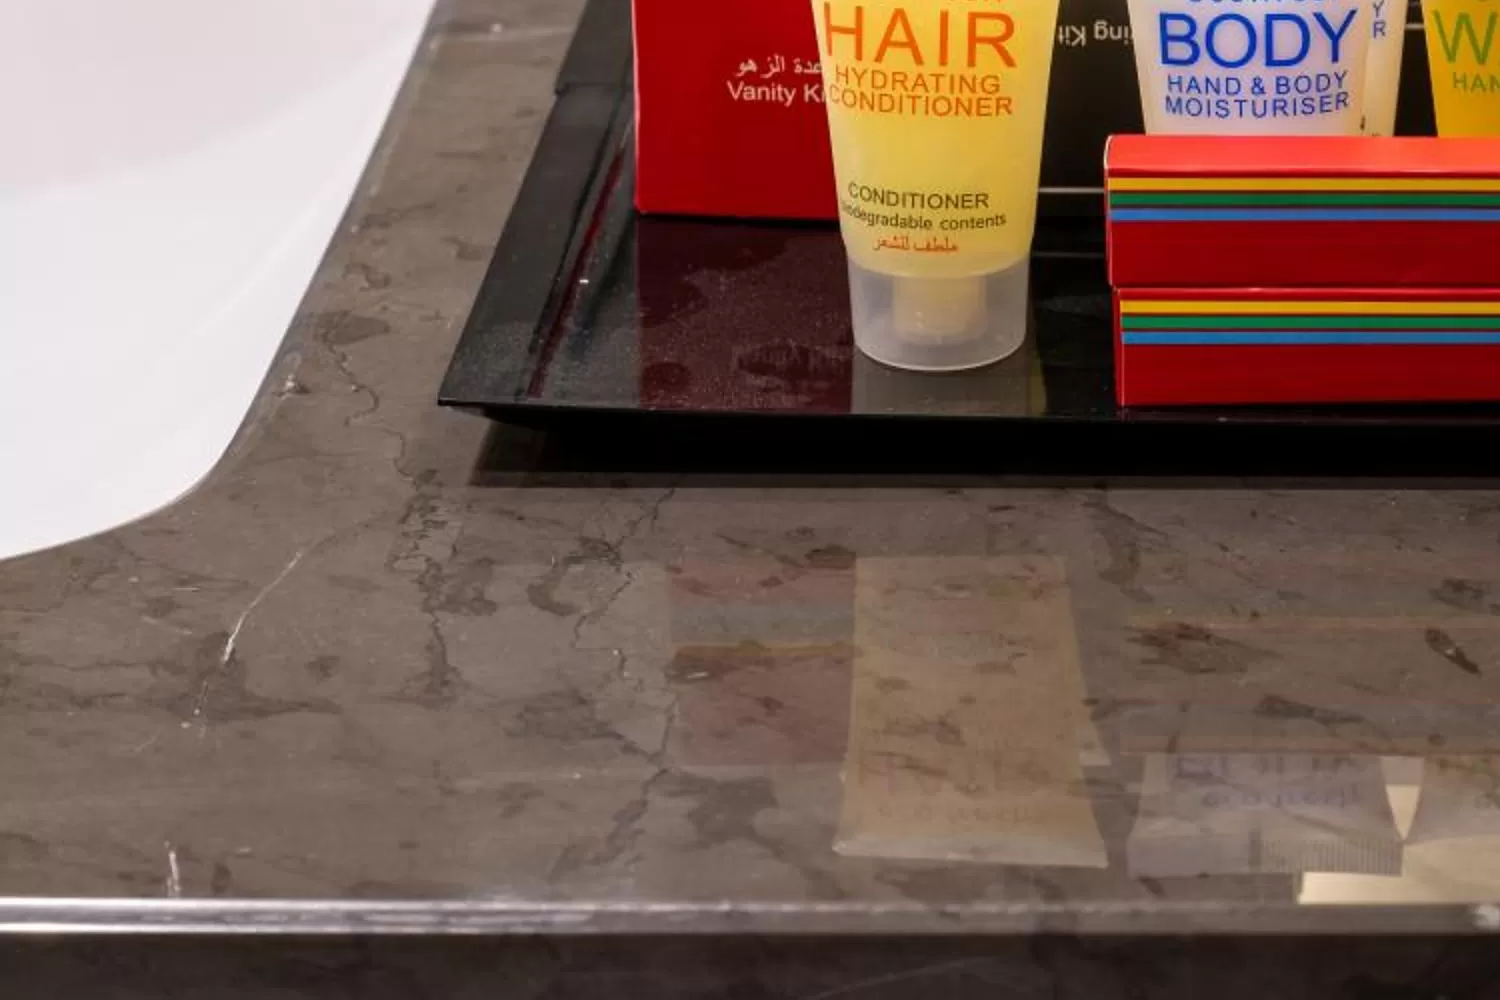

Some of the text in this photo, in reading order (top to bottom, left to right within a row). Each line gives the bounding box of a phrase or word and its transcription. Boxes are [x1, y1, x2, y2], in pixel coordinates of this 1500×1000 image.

[823, 1, 1017, 68] HAIR
[1058, 25, 1086, 47] Kit
[1158, 9, 1358, 68] BODY
[835, 63, 1000, 95] HYDRATING
[1167, 70, 1348, 96] HAND & BODY
[726, 80, 826, 107] Vanity Ki
[829, 83, 1013, 117] CONDITIONER
[1165, 91, 1350, 119] MOISTURISER
[847, 180, 989, 209] CONDITIONER
[940, 213, 1007, 231] contents
